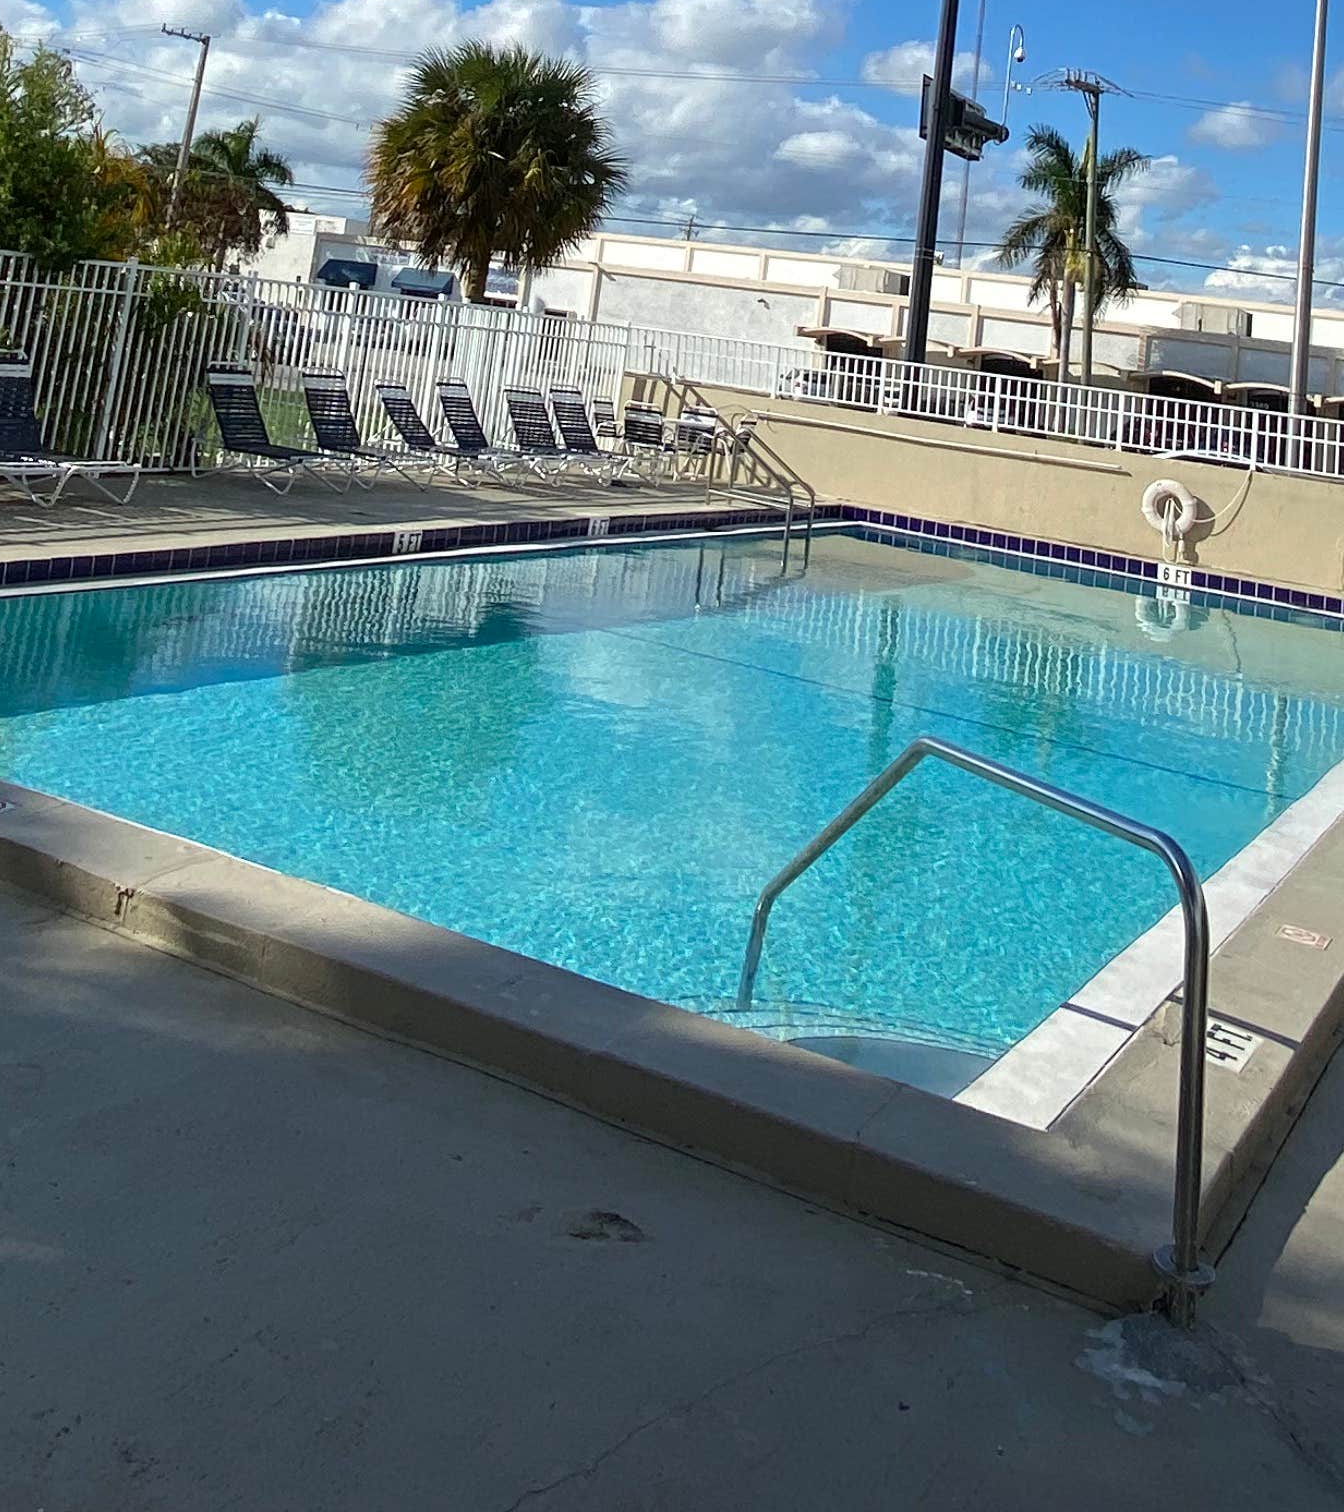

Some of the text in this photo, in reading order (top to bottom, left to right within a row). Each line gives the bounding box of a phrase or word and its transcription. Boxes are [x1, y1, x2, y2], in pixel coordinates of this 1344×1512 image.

[1163, 567, 1190, 585] 6 FT
[1206, 1023, 1254, 1051] FT
